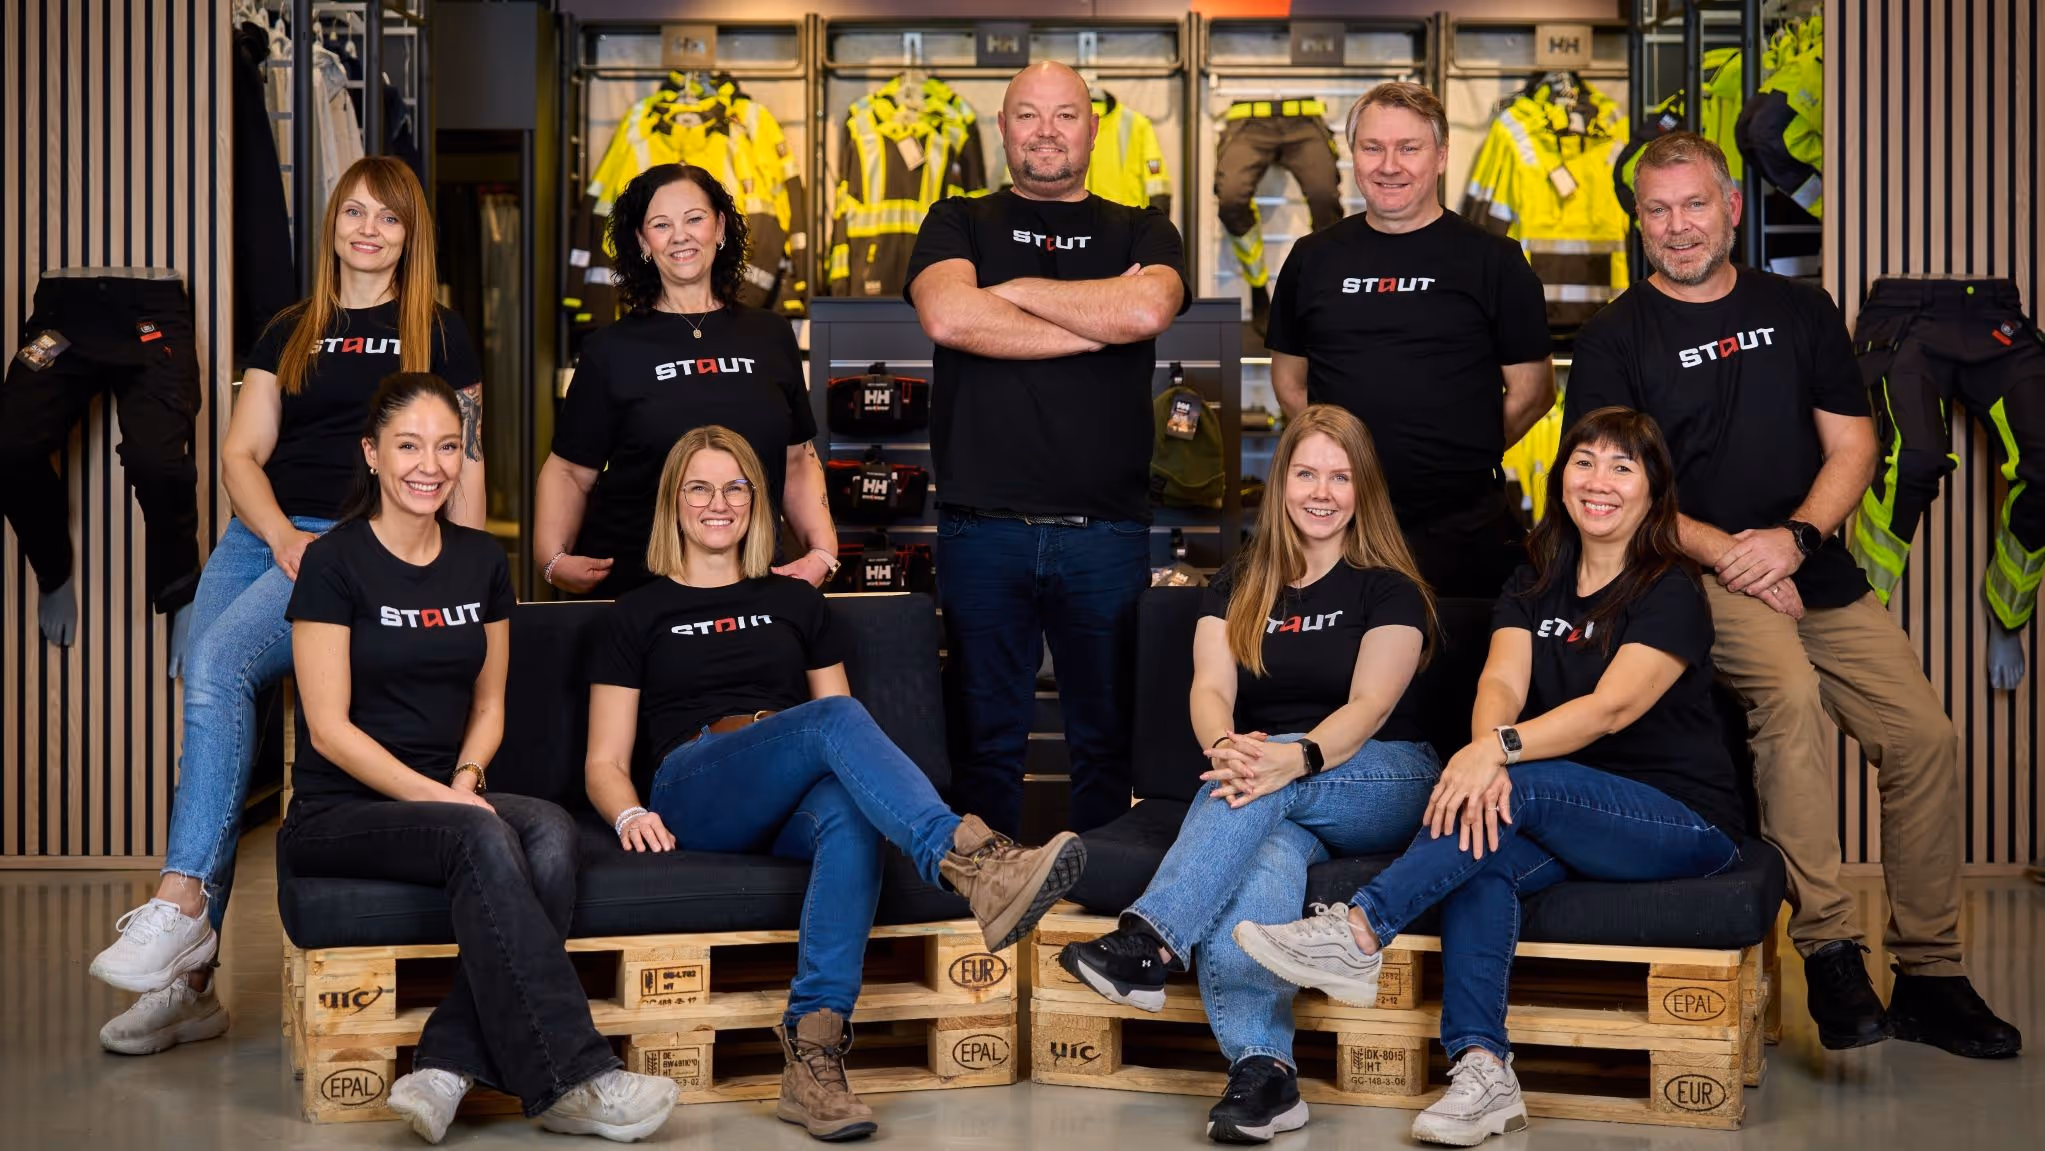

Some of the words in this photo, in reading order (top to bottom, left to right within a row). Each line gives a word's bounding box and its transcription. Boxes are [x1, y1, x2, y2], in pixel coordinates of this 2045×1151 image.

[1549, 36, 1579, 54] HH
[1342, 277, 1435, 293] STAUT
[1679, 328, 1774, 368] STAUT
[655, 358, 755, 381] STAUT
[864, 390, 890, 404] HH
[862, 479, 888, 494] HH
[866, 565, 891, 580] HH
[381, 602, 480, 628] STAUT
[1266, 610, 1343, 633] TAUT
[962, 959, 994, 983] EUR
[1674, 995, 1717, 1013] EPAL
[961, 1043, 1001, 1062] EPAL
[1367, 1049, 1404, 1061] DK-8015
[1368, 1062, 1381, 1072] HT
[331, 1077, 374, 1097] EPAL
[1678, 1081, 1712, 1105] EUR
